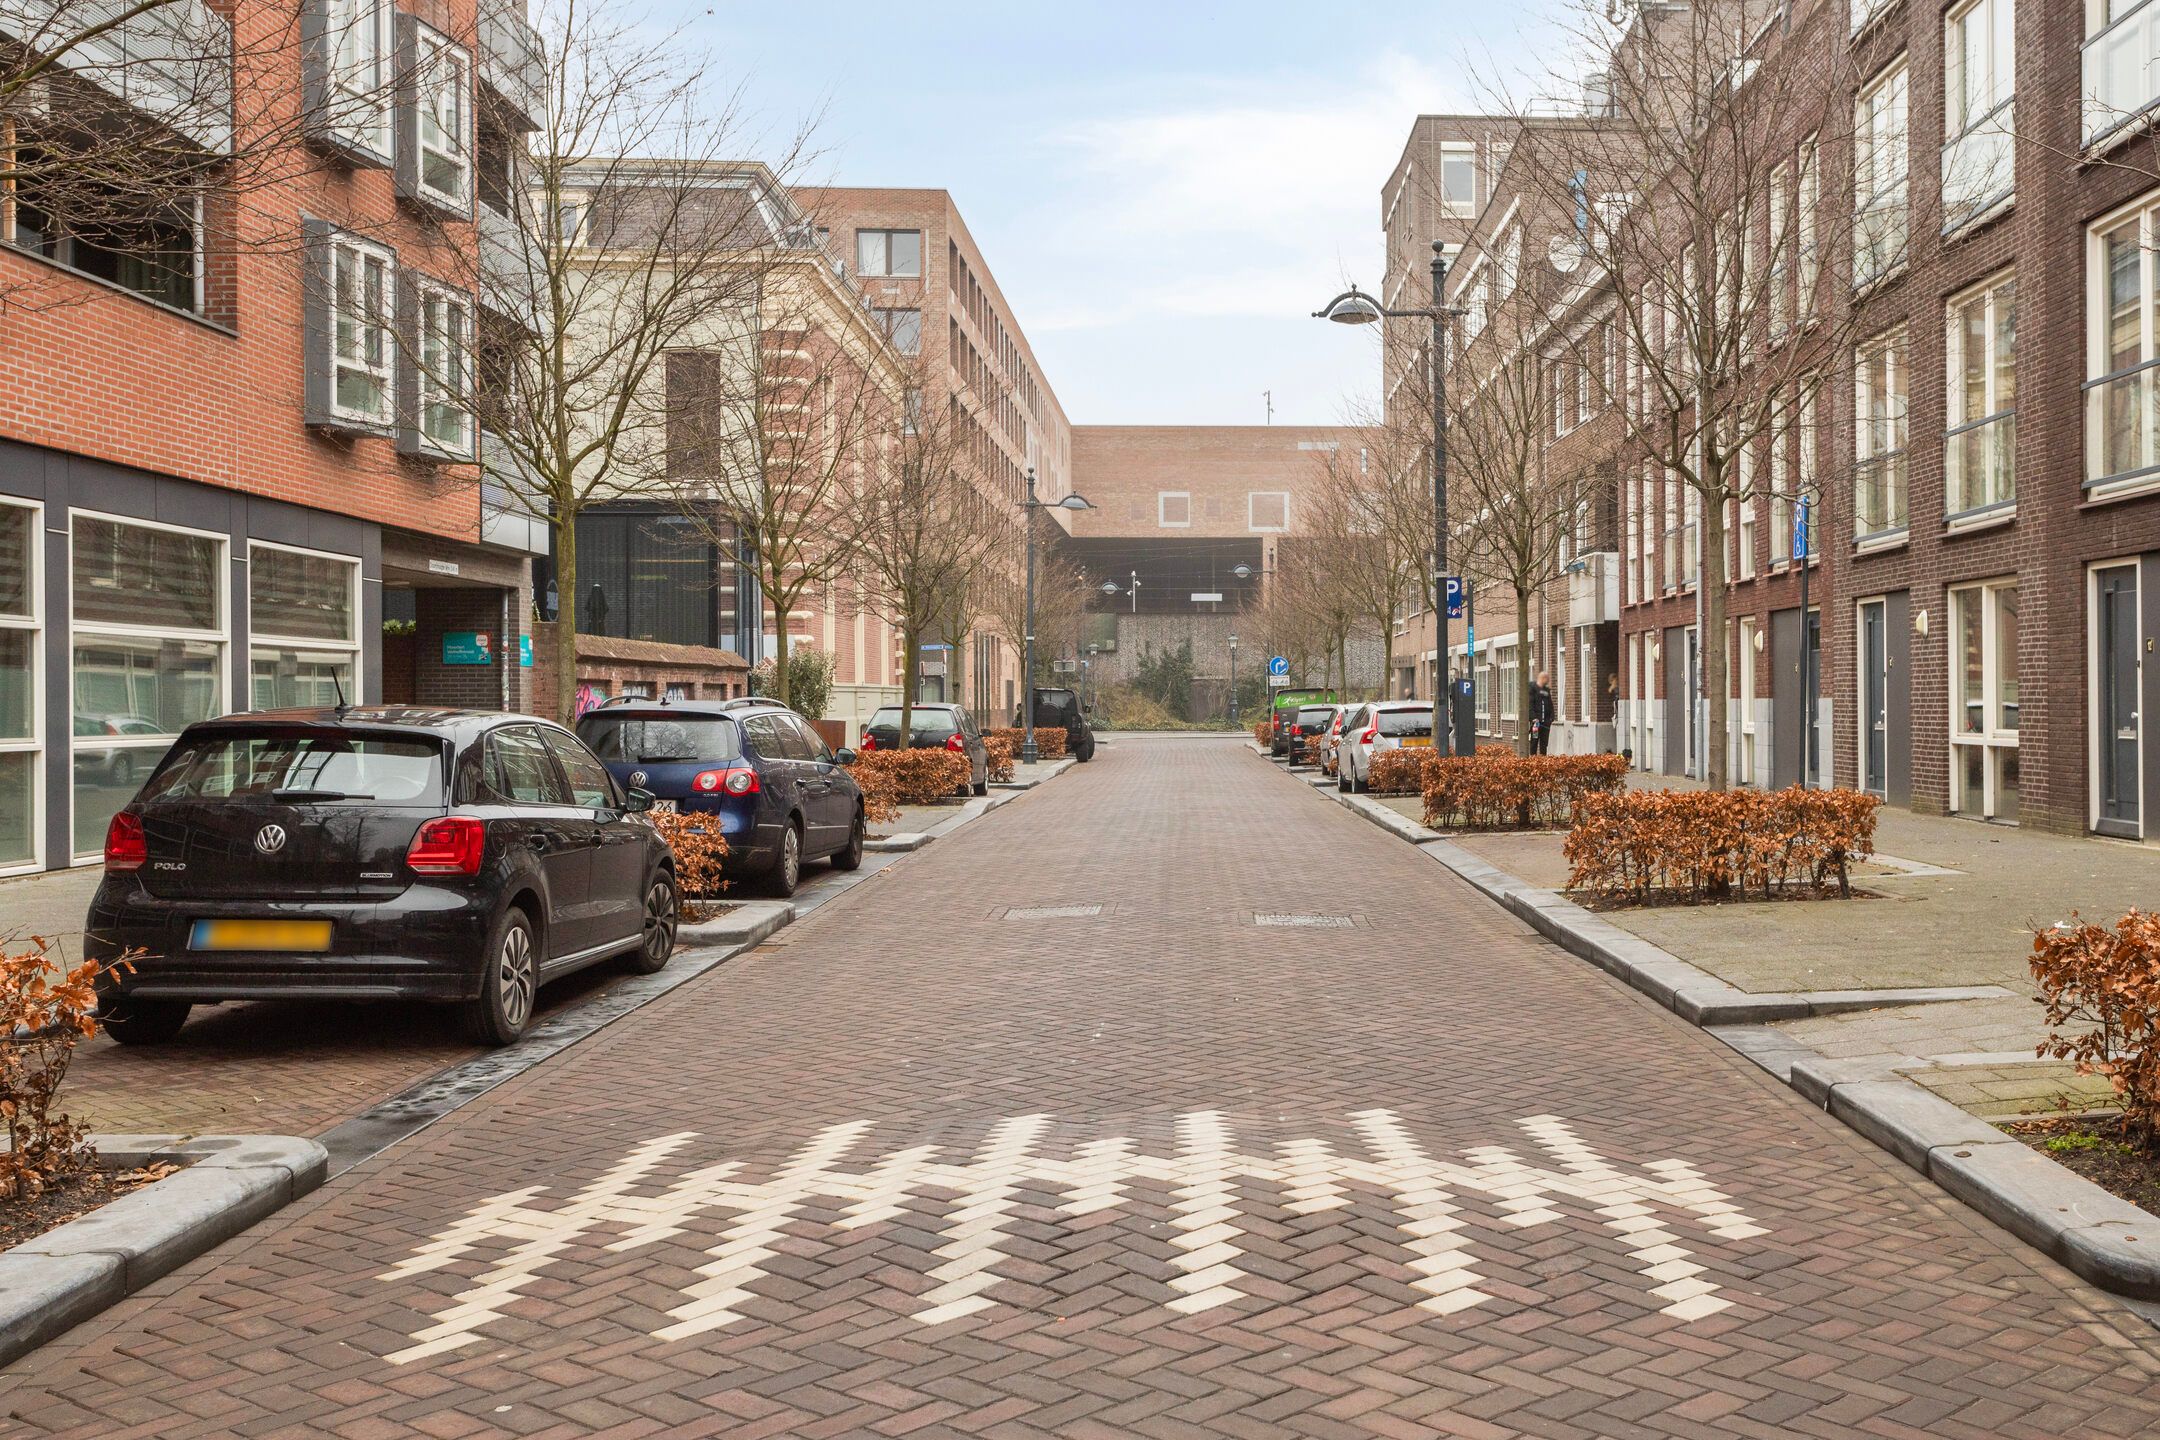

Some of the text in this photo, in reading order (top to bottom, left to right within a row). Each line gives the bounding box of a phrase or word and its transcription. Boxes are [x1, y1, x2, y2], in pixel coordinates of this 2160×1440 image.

[1446, 580, 1459, 600] P
[1463, 682, 1471, 694] P
[154, 862, 187, 871] POLO
